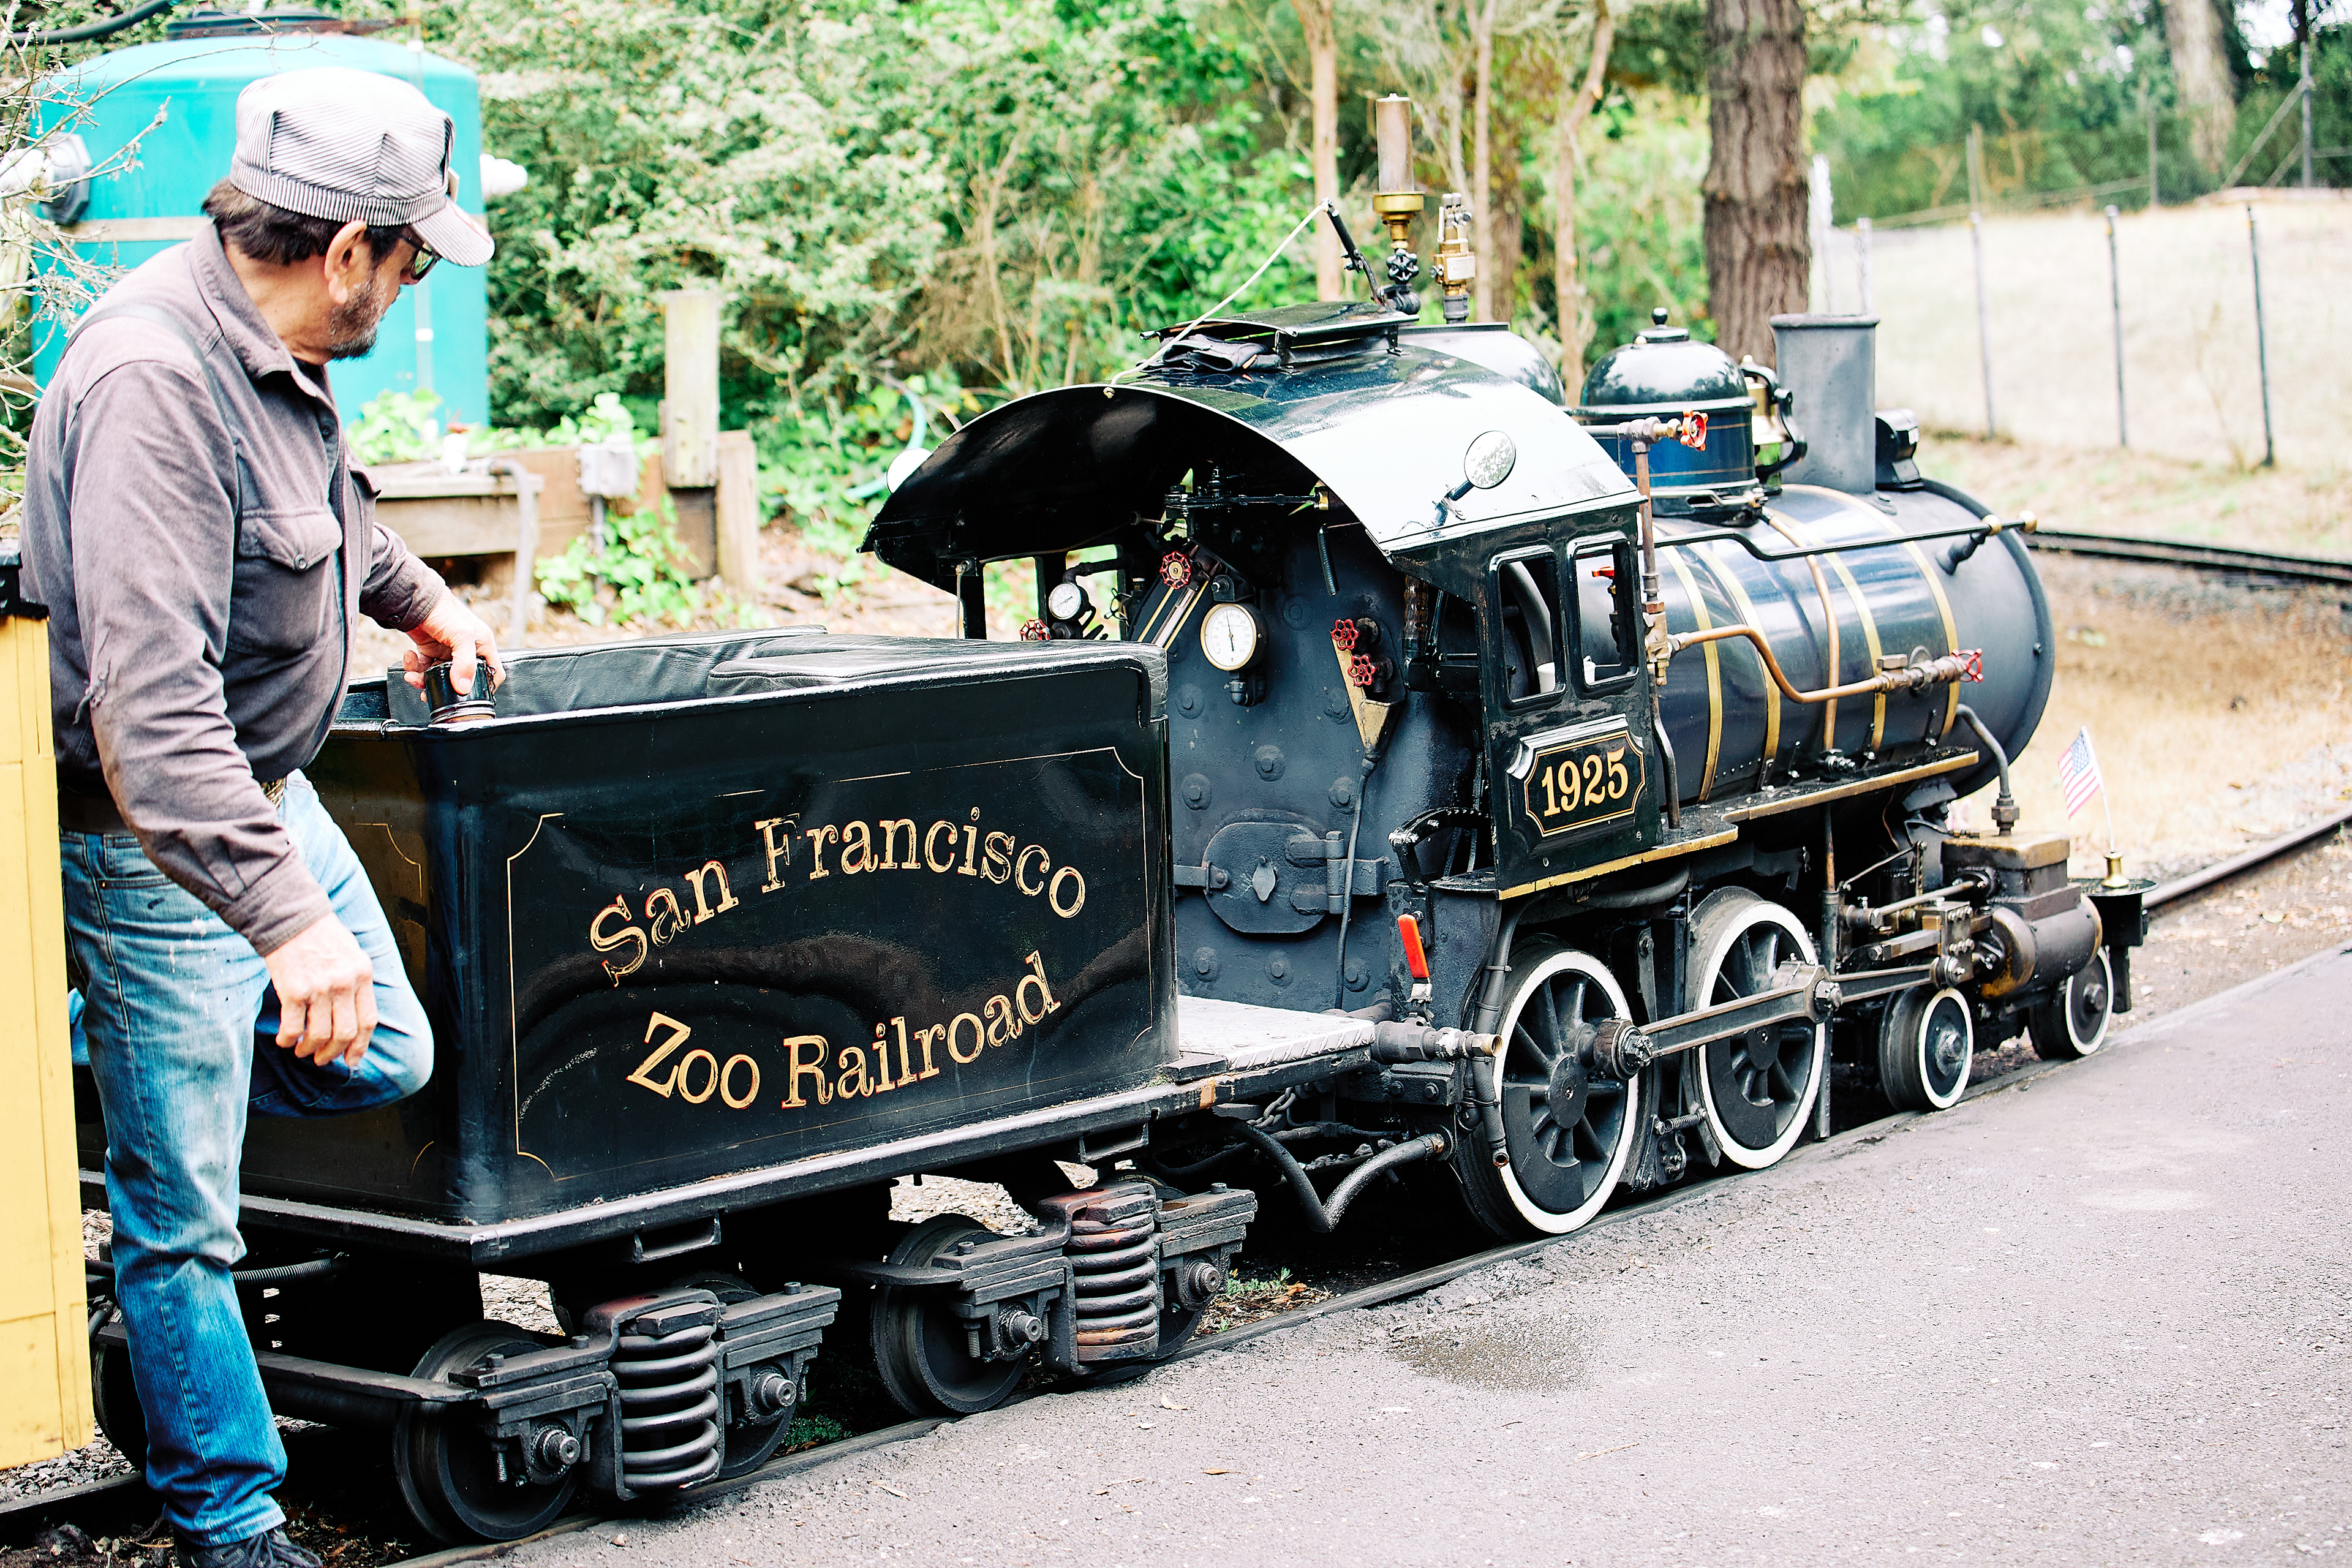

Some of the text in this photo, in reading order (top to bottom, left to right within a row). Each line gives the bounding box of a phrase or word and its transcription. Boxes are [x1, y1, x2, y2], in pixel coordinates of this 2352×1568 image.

[1541, 745, 1629, 817] 1925
[590, 807, 1086, 988] San Francisco
[626, 950, 1061, 1110] Zoo Railroad
